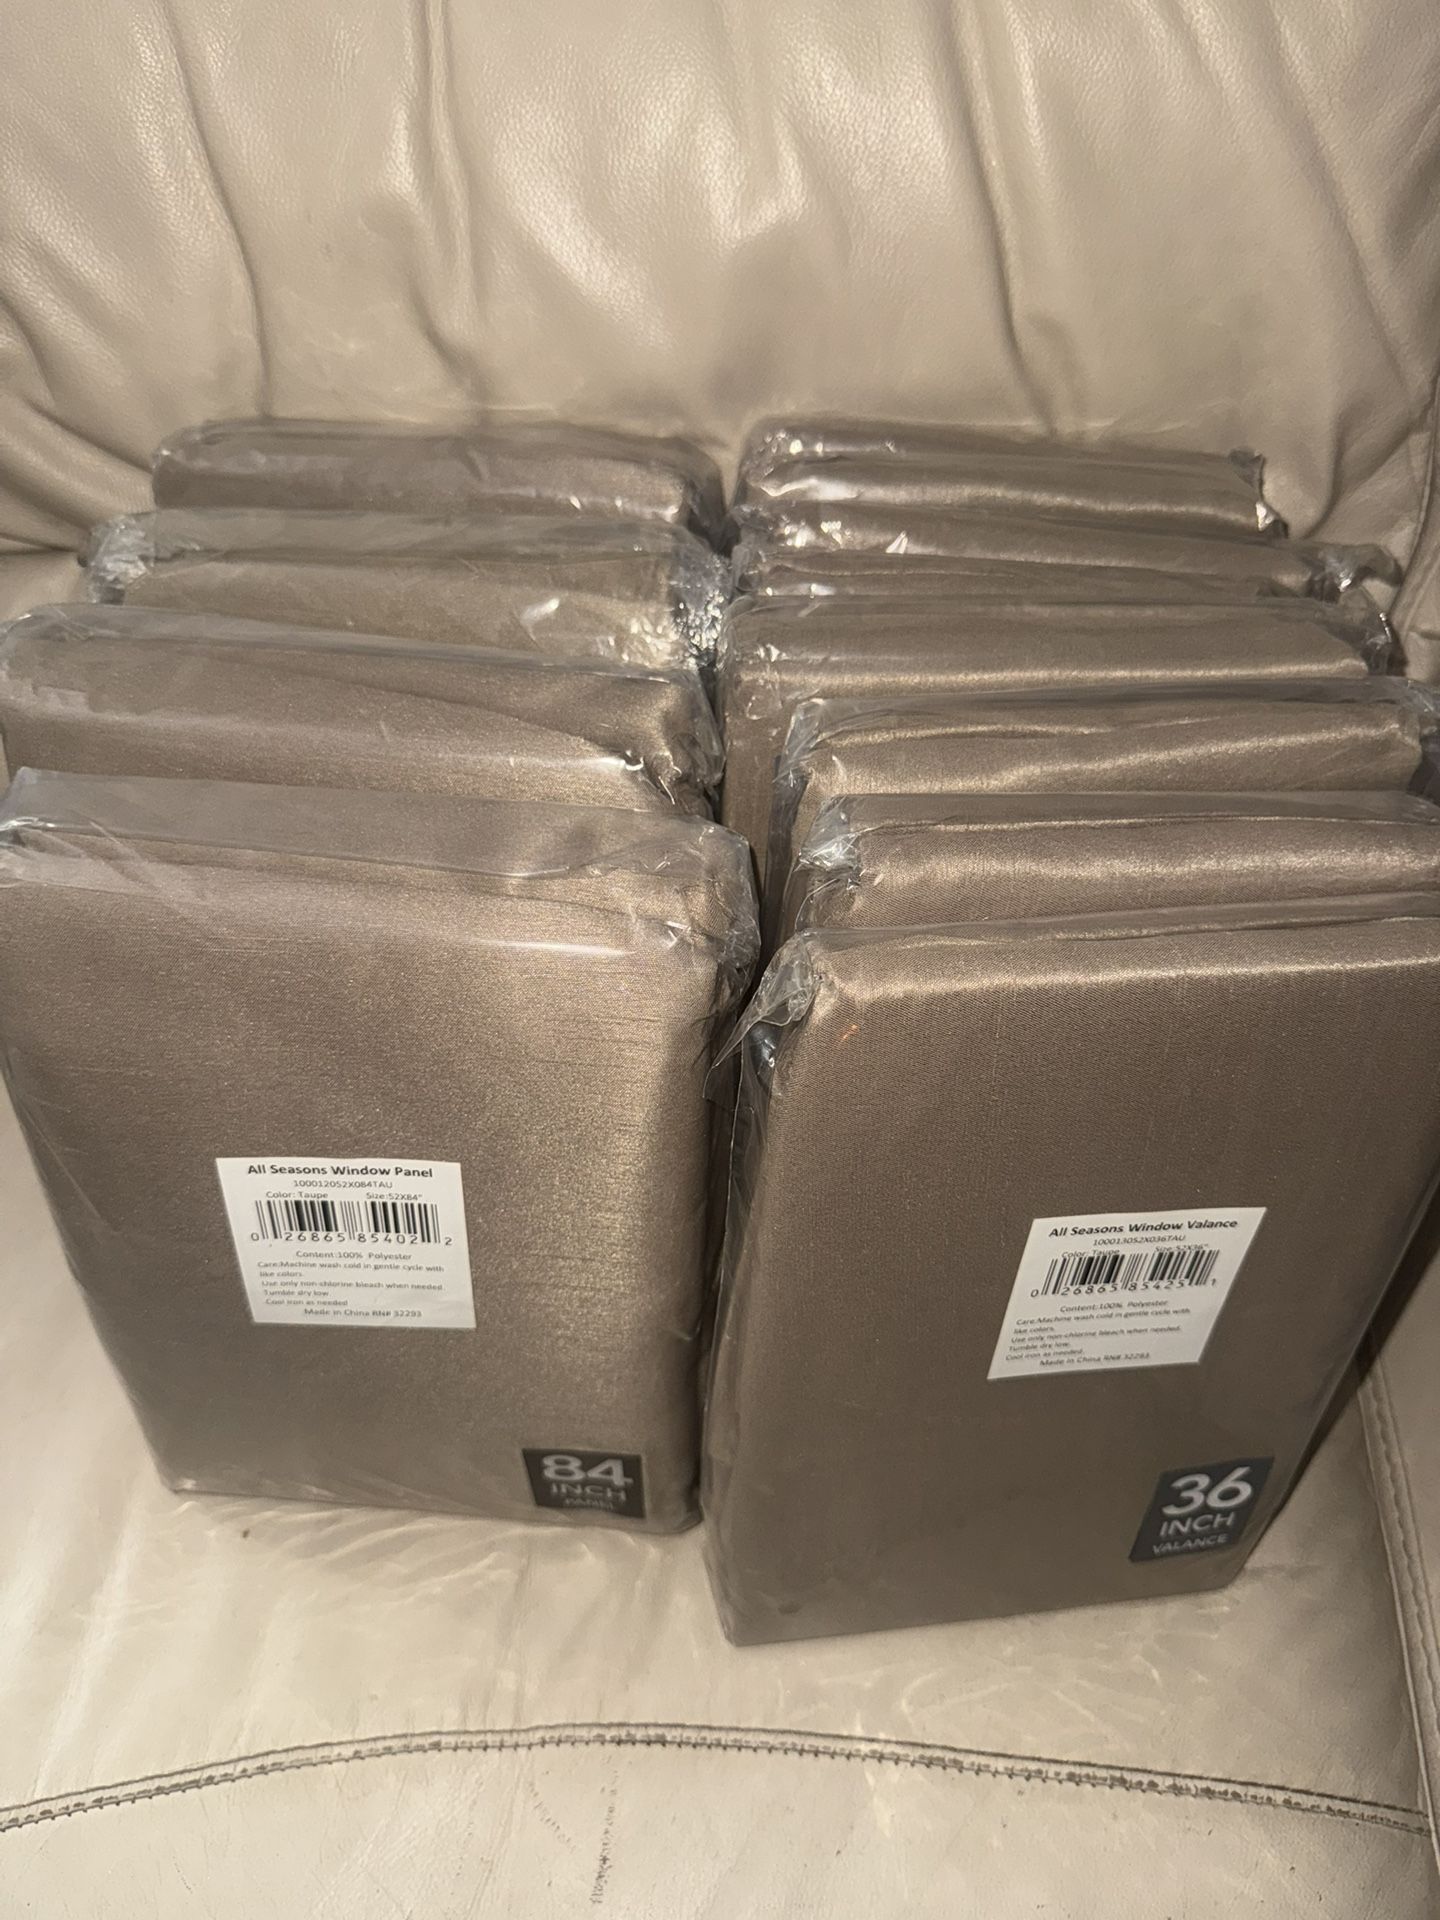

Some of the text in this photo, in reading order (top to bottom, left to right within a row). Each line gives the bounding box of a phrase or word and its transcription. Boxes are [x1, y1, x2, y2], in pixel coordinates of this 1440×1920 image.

[248, 1164, 433, 1178] All Seasons Window Panel
[266, 1191, 296, 1199] Color:
[298, 1191, 328, 1200] Taupe
[1049, 1219, 1238, 1238] All Seasons Window Valance
[250, 1232, 260, 1242] 0
[444, 1236, 453, 1246] 2
[368, 1251, 412, 1261] Polyester
[374, 1263, 400, 1271] gentle
[402, 1264, 424, 1272] cycle
[280, 1280, 298, 1288] only
[355, 1281, 384, 1289] bleach
[386, 1282, 409, 1290] when
[1030, 1288, 1039, 1298] 0
[1127, 1300, 1168, 1309] Polyester
[344, 1309, 370, 1317] China
[1123, 1310, 1149, 1319] gentle
[1151, 1309, 1171, 1317] cycle
[1172, 1307, 1190, 1315] with
[542, 1454, 634, 1487] 84
[550, 1482, 627, 1501] INCH
[1161, 1465, 1253, 1516] 36
[1159, 1511, 1235, 1538] INCH
[1152, 1533, 1229, 1555] VALANCE
